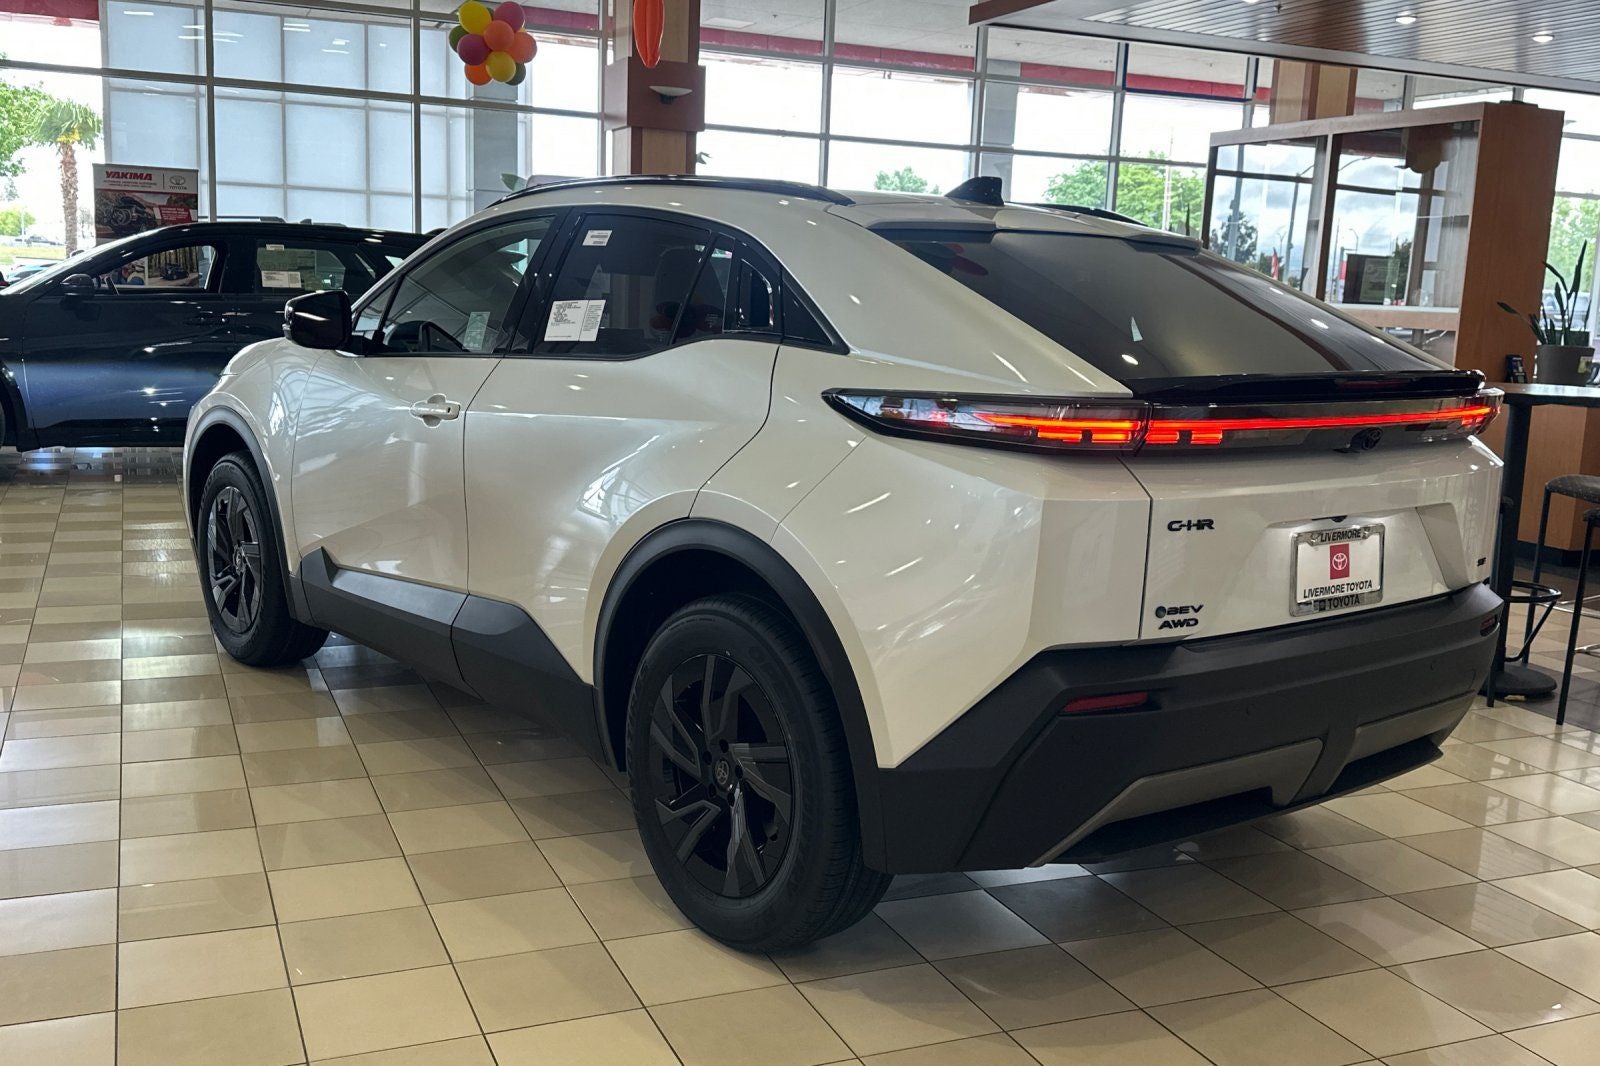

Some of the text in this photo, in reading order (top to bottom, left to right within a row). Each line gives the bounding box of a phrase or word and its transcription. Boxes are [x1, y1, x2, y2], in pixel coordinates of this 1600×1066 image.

[105, 170, 152, 180] YAKIMA
[1167, 518, 1215, 532] C-HR
[1319, 529, 1361, 542] LIVERMORE
[1303, 579, 1373, 599] LIVERMORE TOYOTA
[1327, 594, 1360, 609] TOYOTA
[1166, 604, 1204, 615] BEV
[1158, 617, 1199, 630] AWD
